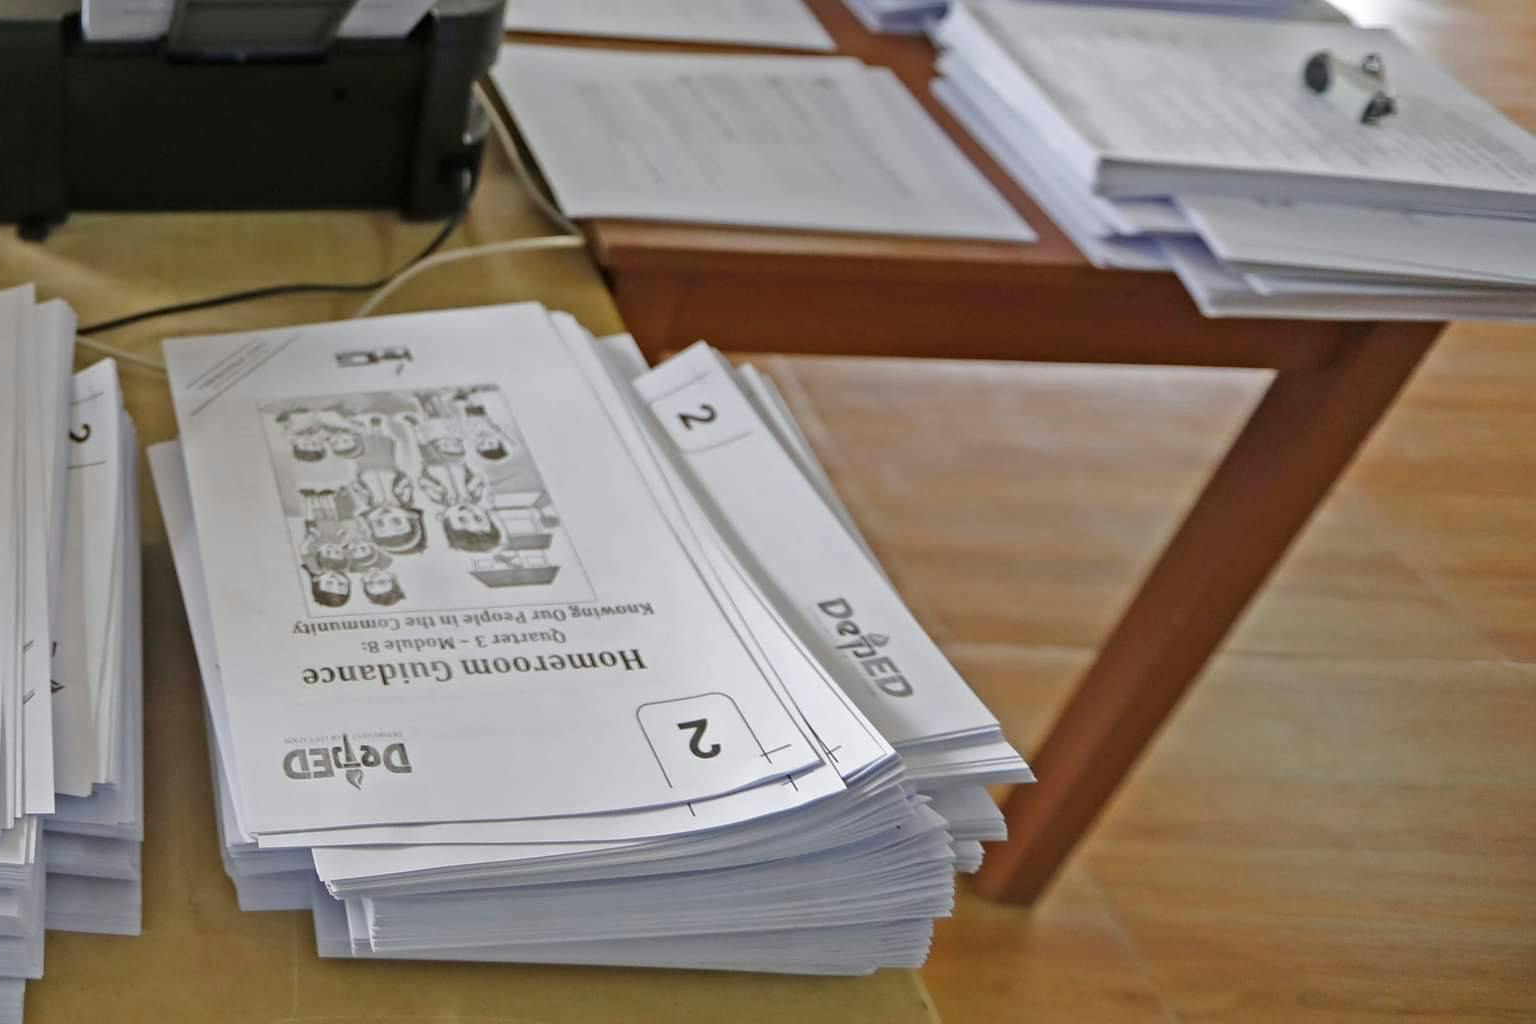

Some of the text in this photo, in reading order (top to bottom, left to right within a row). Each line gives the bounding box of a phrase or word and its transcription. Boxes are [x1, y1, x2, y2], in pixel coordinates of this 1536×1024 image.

[678, 404, 717, 430] 2
[292, 602, 654, 636] Knowing Our People in the Community
[361, 639, 381, 654] 8:
[385, 635, 456, 651] Module
[474, 632, 487, 648] 3
[491, 628, 567, 647] Quarter
[817, 598, 914, 698] DepED
[302, 648, 648, 687] Homeroom Guidance
[677, 718, 721, 759] 2
[283, 733, 413, 784] DepED
